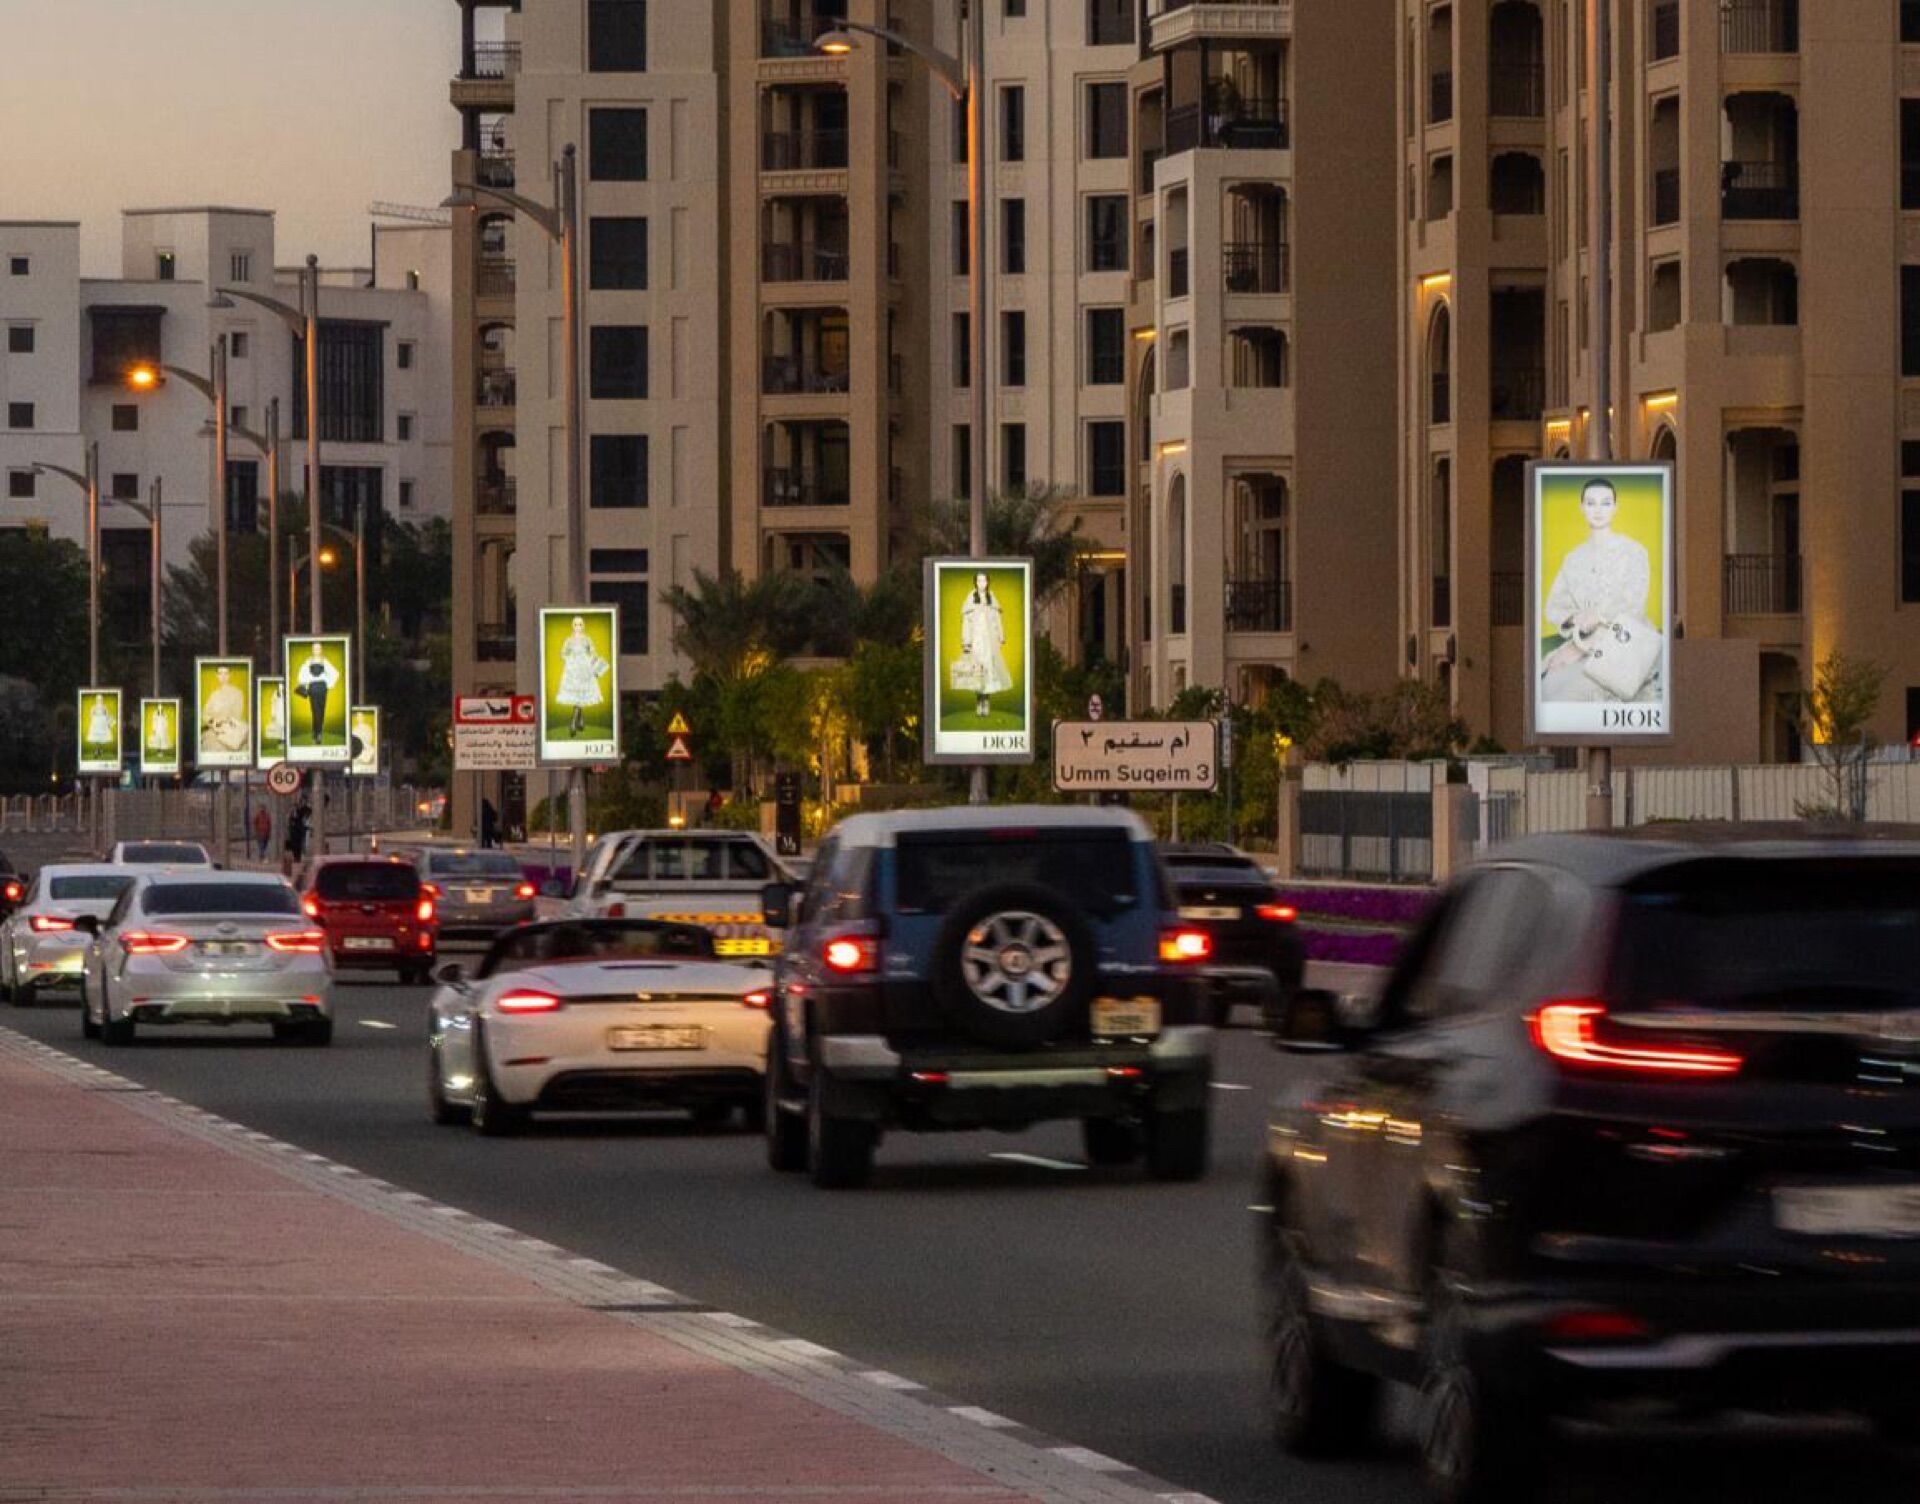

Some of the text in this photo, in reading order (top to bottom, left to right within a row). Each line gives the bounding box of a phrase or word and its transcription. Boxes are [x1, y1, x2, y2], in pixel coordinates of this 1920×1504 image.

[1603, 709, 1661, 727] DIOR
[982, 735, 1024, 749] DIOR
[274, 771, 295, 784] 60
[1060, 764, 1209, 784] Umm Suqeim 3
